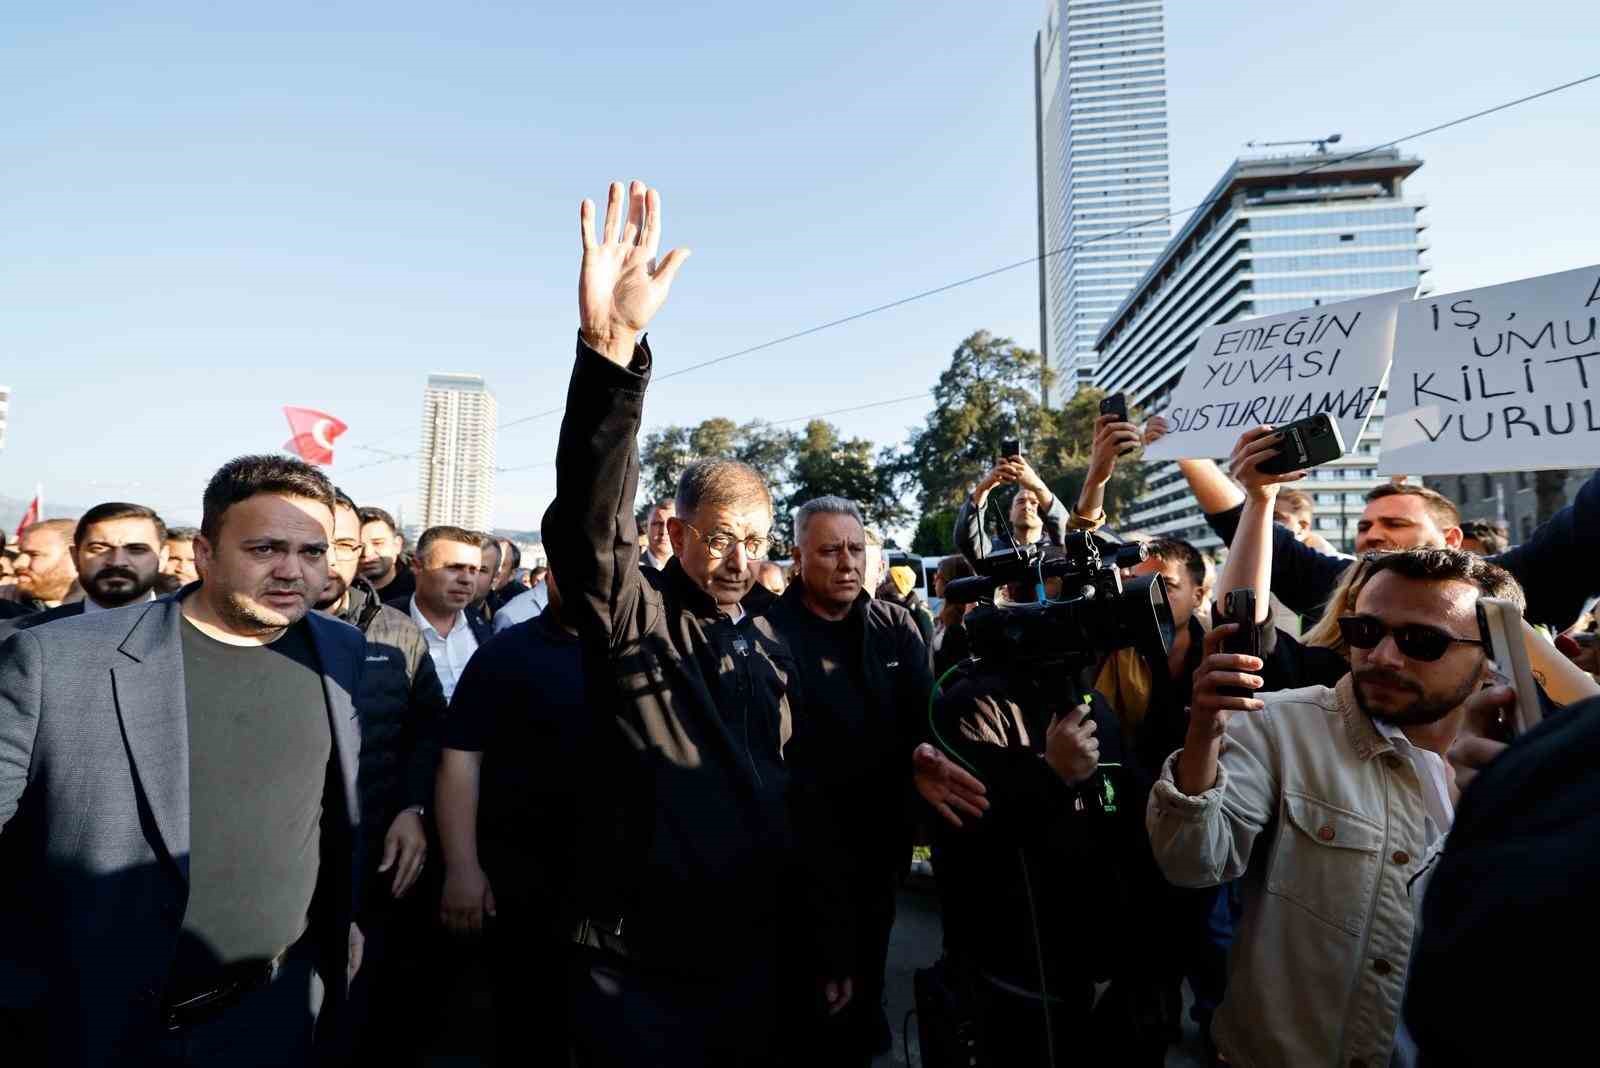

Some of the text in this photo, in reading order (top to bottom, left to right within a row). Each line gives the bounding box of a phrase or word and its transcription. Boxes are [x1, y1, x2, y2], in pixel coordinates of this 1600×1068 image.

[1213, 311, 1361, 356] EMEĞİN
[1203, 349, 1341, 390] YUVASI
[1166, 386, 1379, 434] SUSTURULAMAZ
